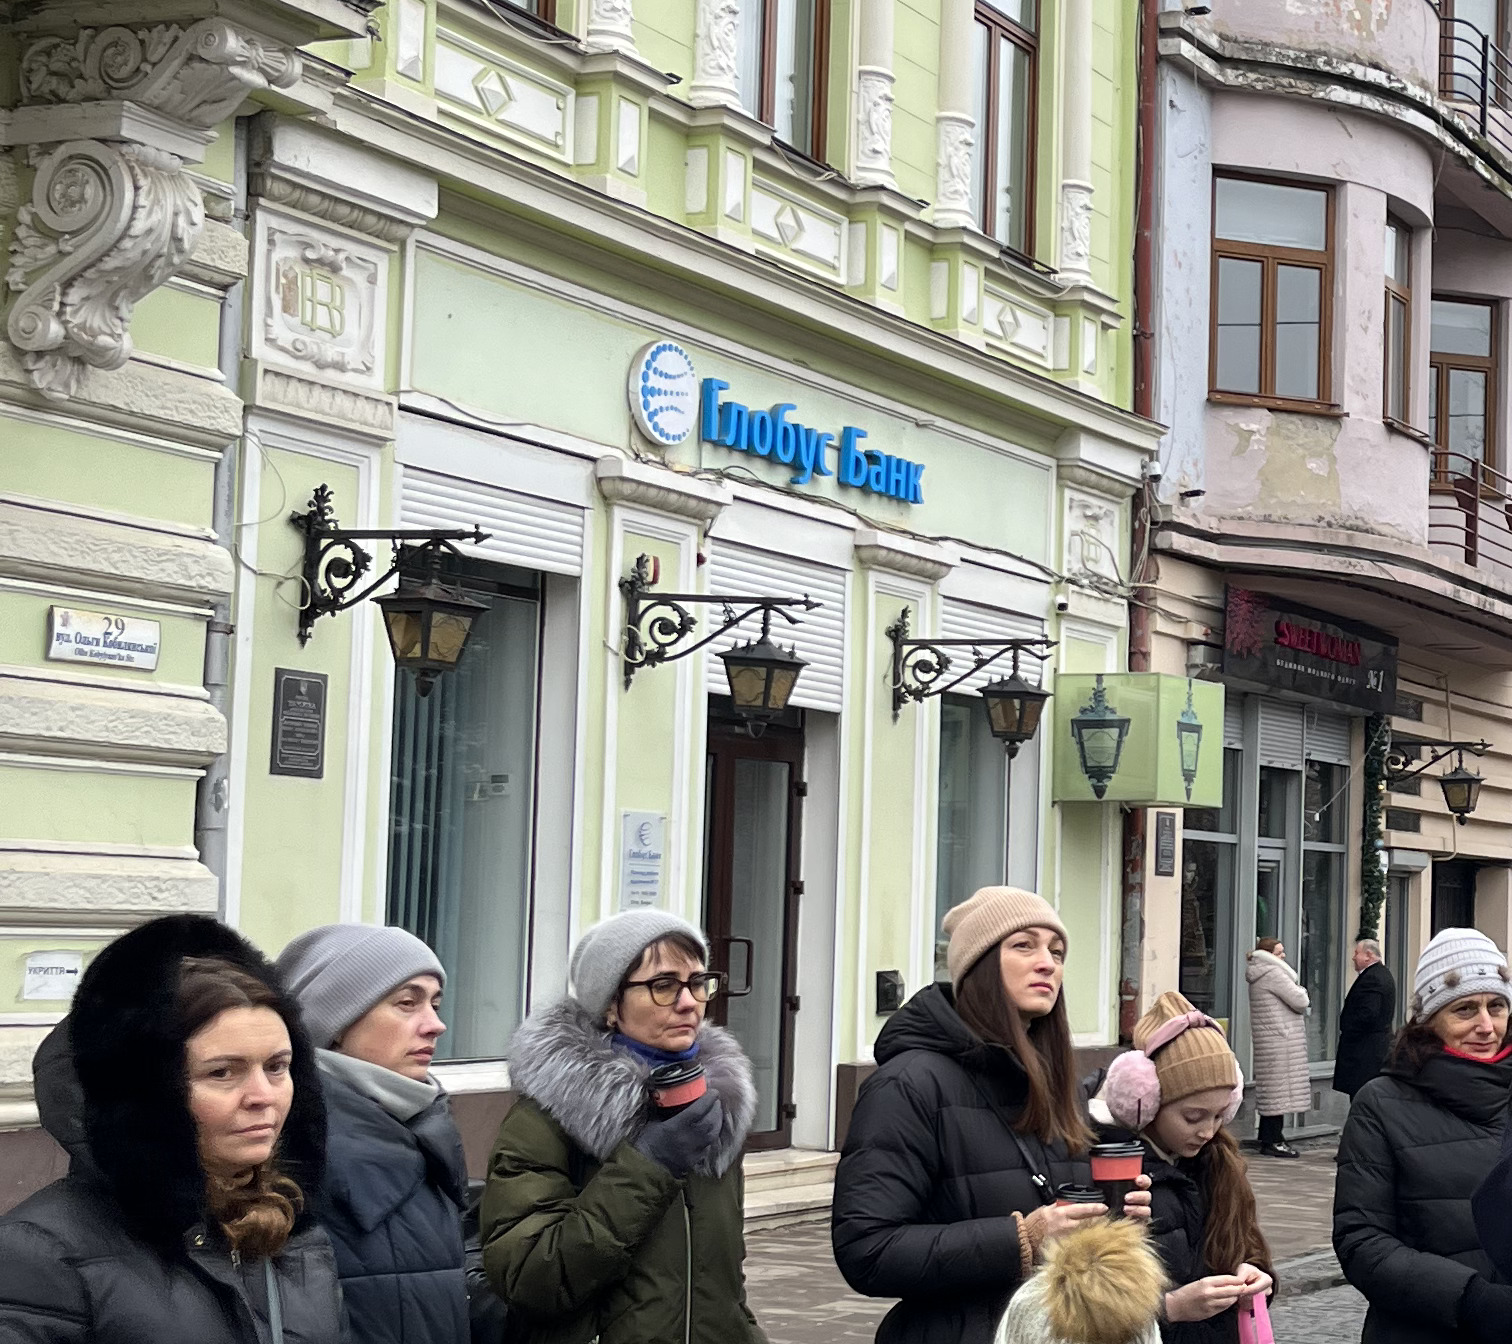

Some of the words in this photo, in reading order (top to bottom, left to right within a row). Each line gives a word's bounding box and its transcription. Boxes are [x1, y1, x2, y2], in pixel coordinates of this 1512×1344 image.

[702, 377, 835, 484] Глобус
[838, 426, 925, 504] Банк
[103, 616, 125, 641] 29
[75, 632, 100, 647] Ольги
[28, 967, 65, 975] УКРИТТЯ
